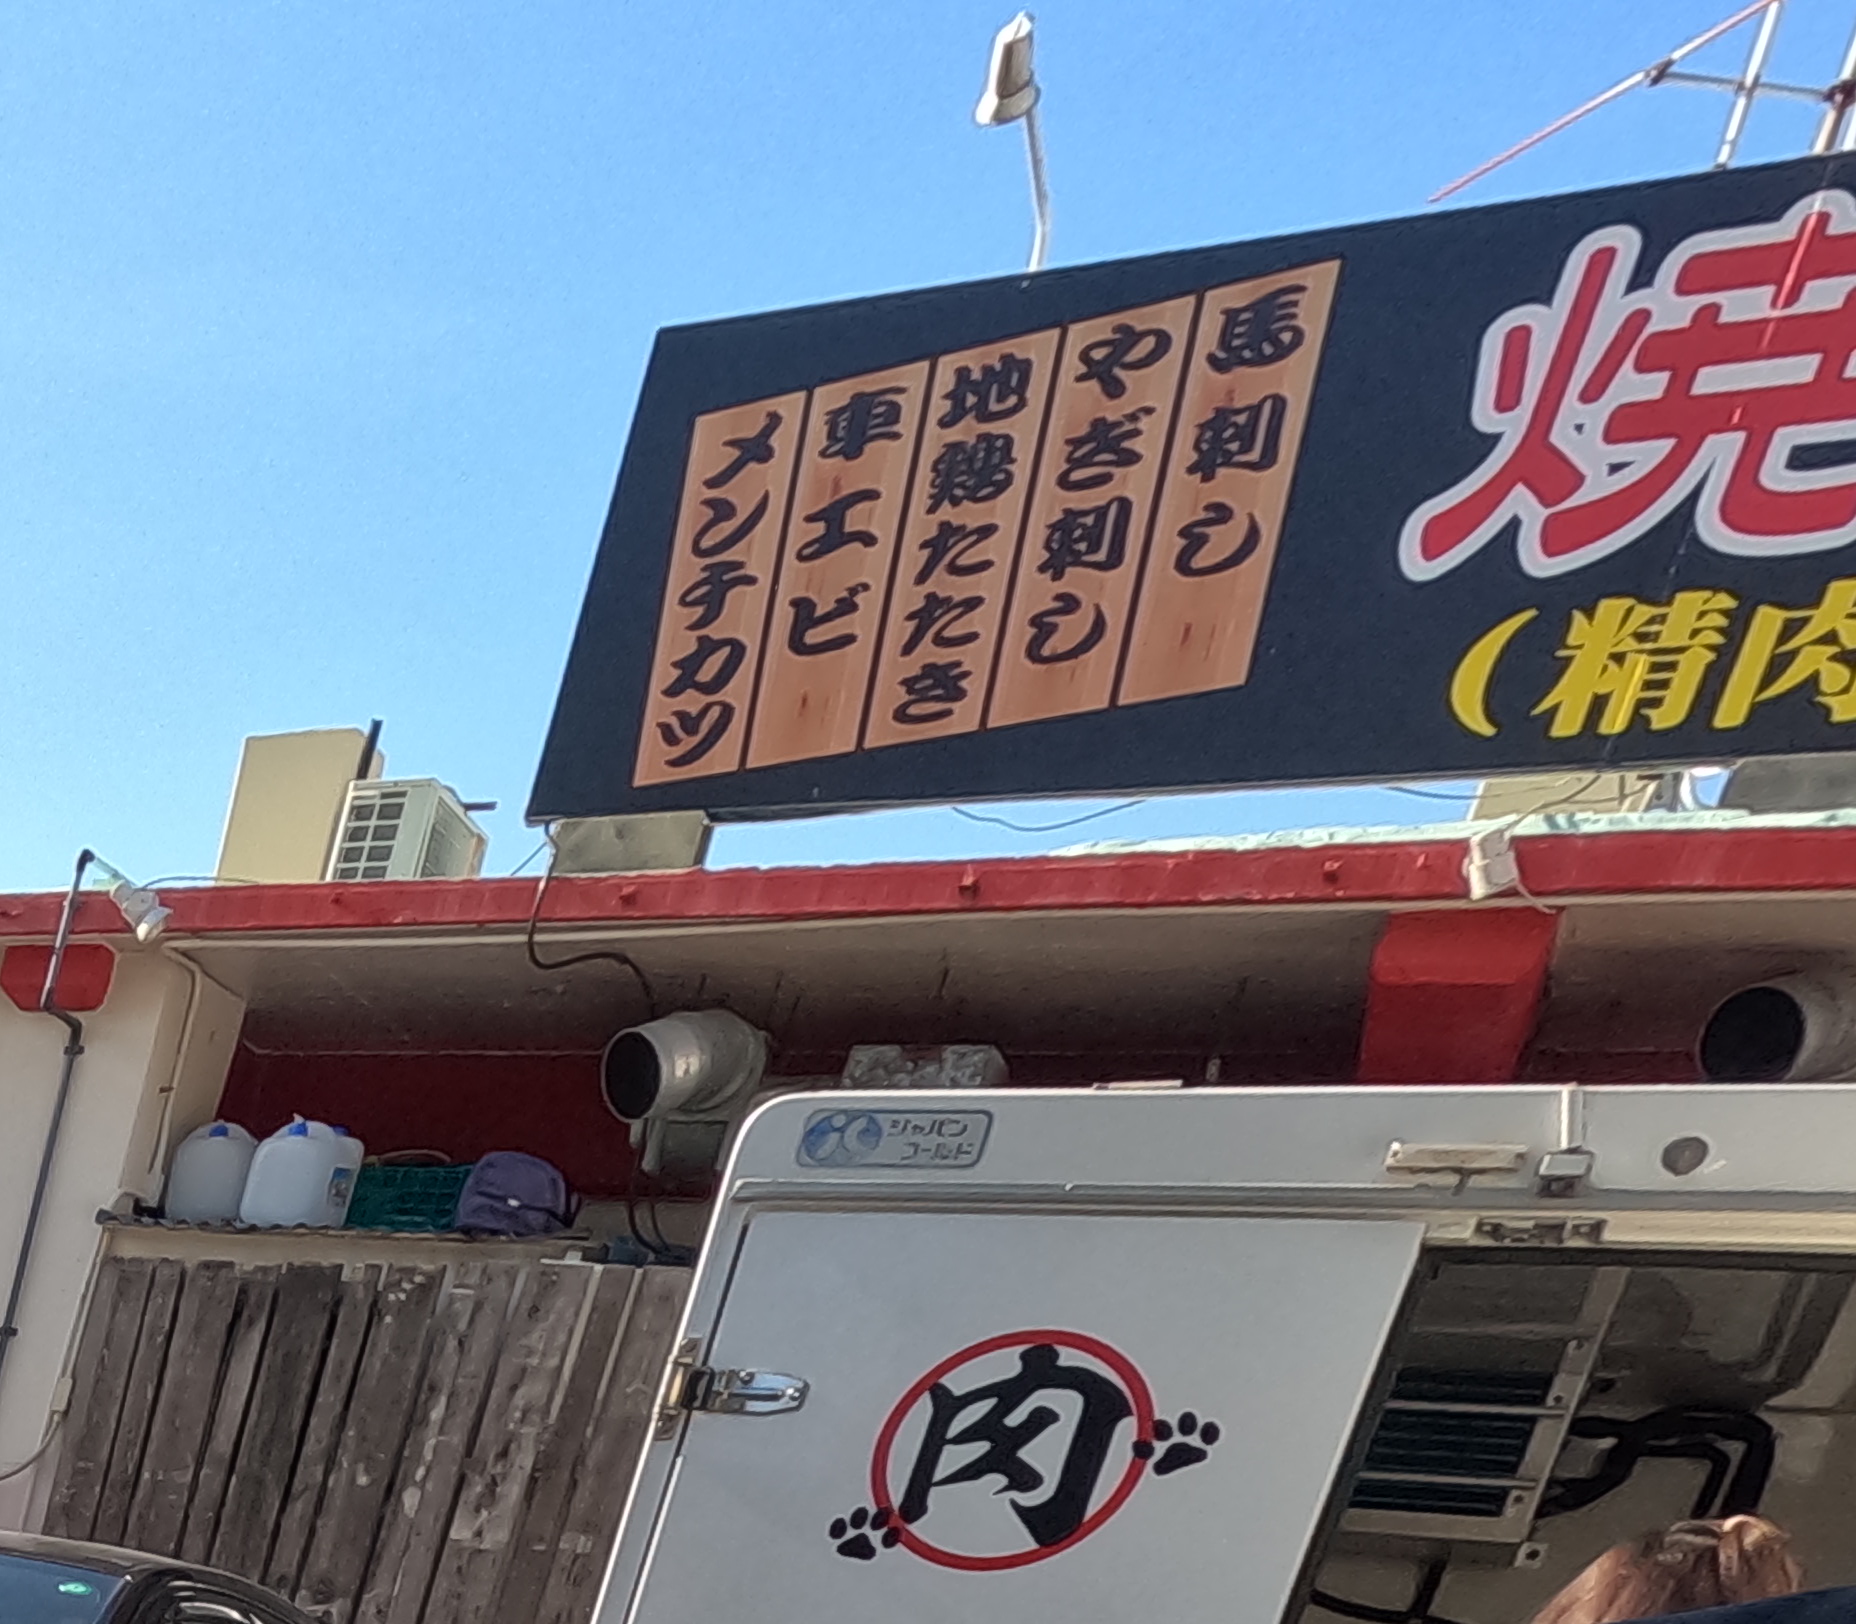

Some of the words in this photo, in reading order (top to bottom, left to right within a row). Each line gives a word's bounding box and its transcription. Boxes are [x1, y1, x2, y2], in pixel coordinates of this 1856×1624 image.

[657, 410, 785, 768] メンチカツ
[785, 386, 903, 656] 車エビ
[892, 352, 1030, 725] 地鶏たたき
[1022, 322, 1172, 664] やぎ刺し
[1172, 284, 1309, 578] 馬刺し
[895, 1343, 1135, 1547] 肉
